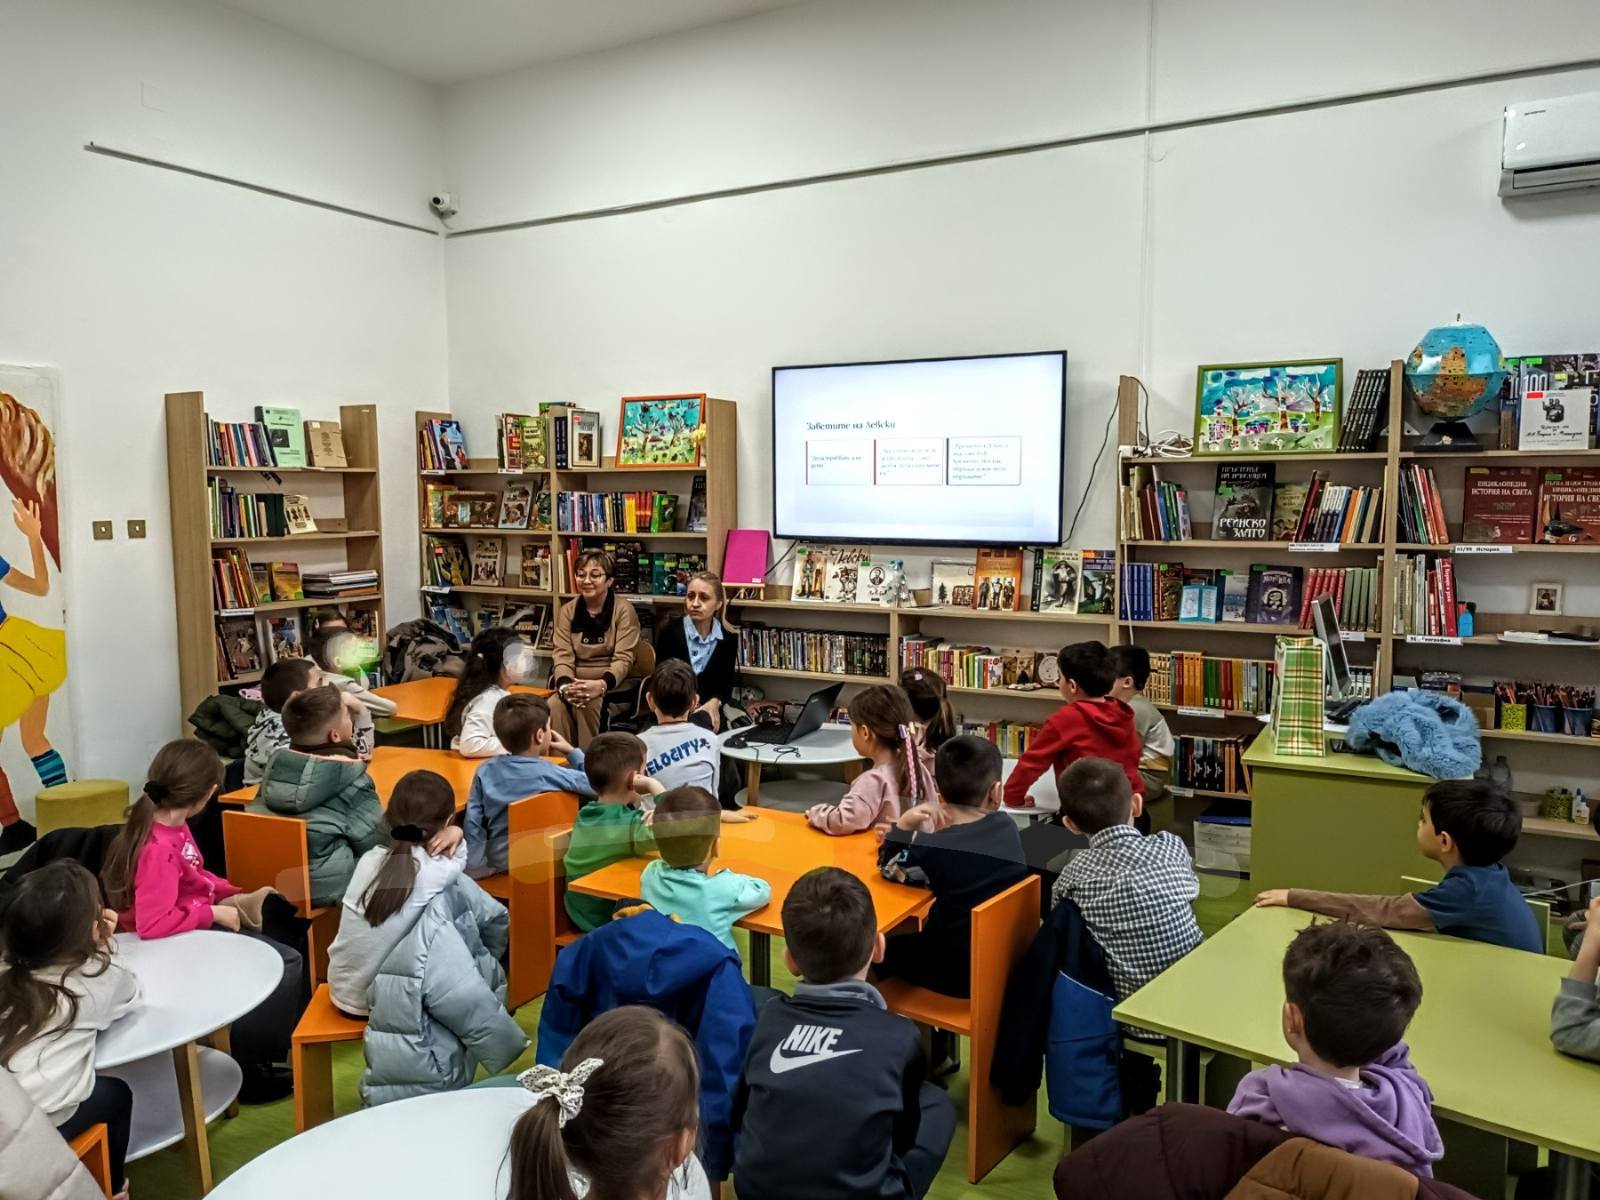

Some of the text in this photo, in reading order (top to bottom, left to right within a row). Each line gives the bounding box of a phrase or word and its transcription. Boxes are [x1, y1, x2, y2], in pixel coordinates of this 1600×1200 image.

[1511, 488, 1533, 496] СВЕТА
[1586, 494, 1600, 502] СВЕ
[781, 1024, 844, 1054] NIKE
